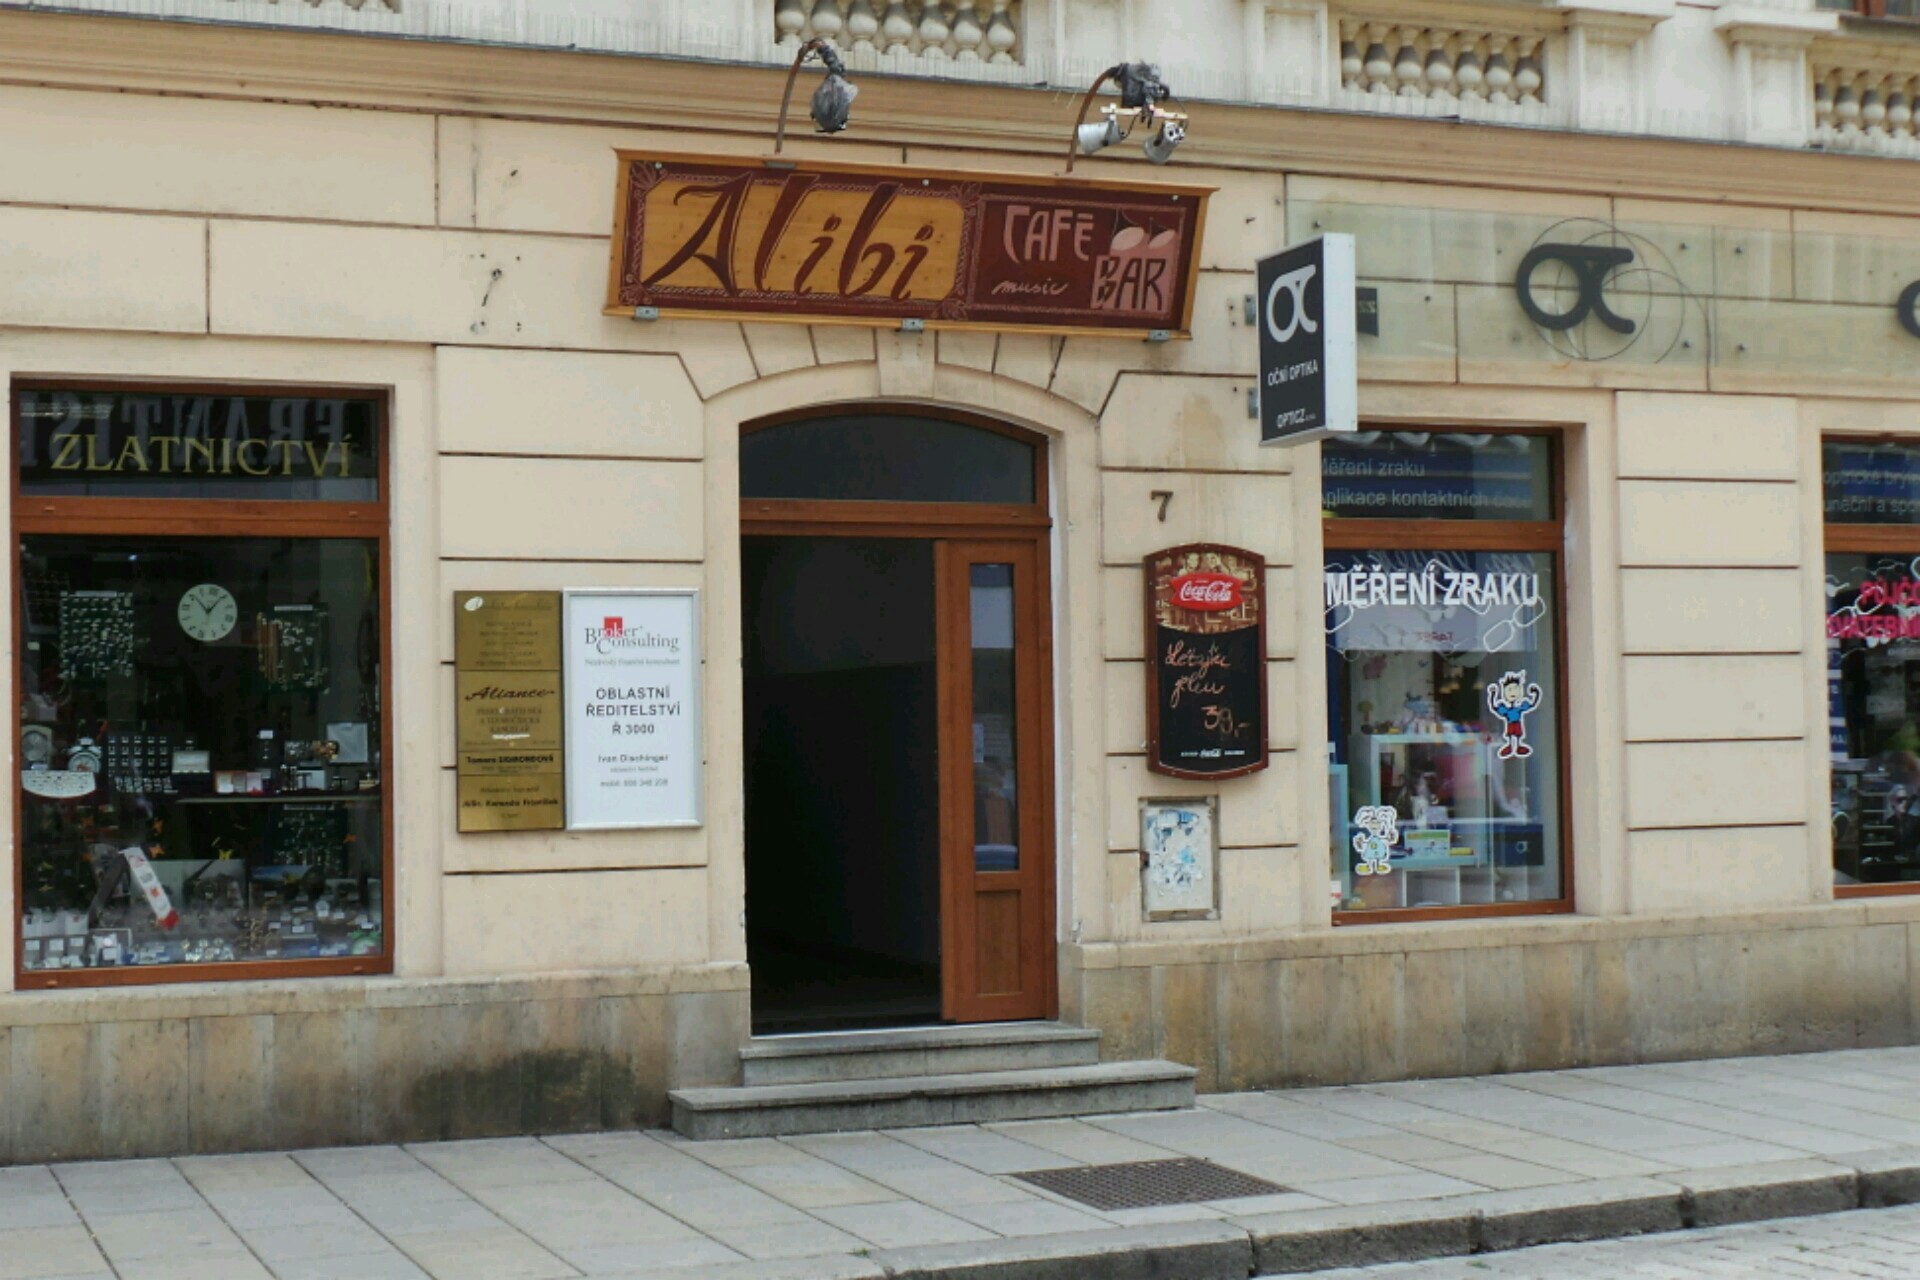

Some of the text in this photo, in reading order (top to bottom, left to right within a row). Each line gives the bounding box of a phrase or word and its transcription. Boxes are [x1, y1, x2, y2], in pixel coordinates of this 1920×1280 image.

[642, 172, 935, 300] Alibi
[991, 277, 1069, 295] music
[1091, 255, 1168, 311] BAR
[1288, 358, 1318, 381] OPTIKA
[50, 433, 353, 477] ZLATNICTVÍ
[1378, 460, 1425, 477] zraku
[1151, 490, 1174, 522] 7
[1391, 489, 1490, 507] kontaktních
[1181, 580, 1233, 602] Coca-Cola
[1325, 563, 1539, 606] MĚŘENÍ ZRAKU
[596, 633, 680, 654] Consulting
[595, 684, 671, 700] OBLASTNÍ
[586, 701, 681, 717] ŘEDITELSTVÍ
